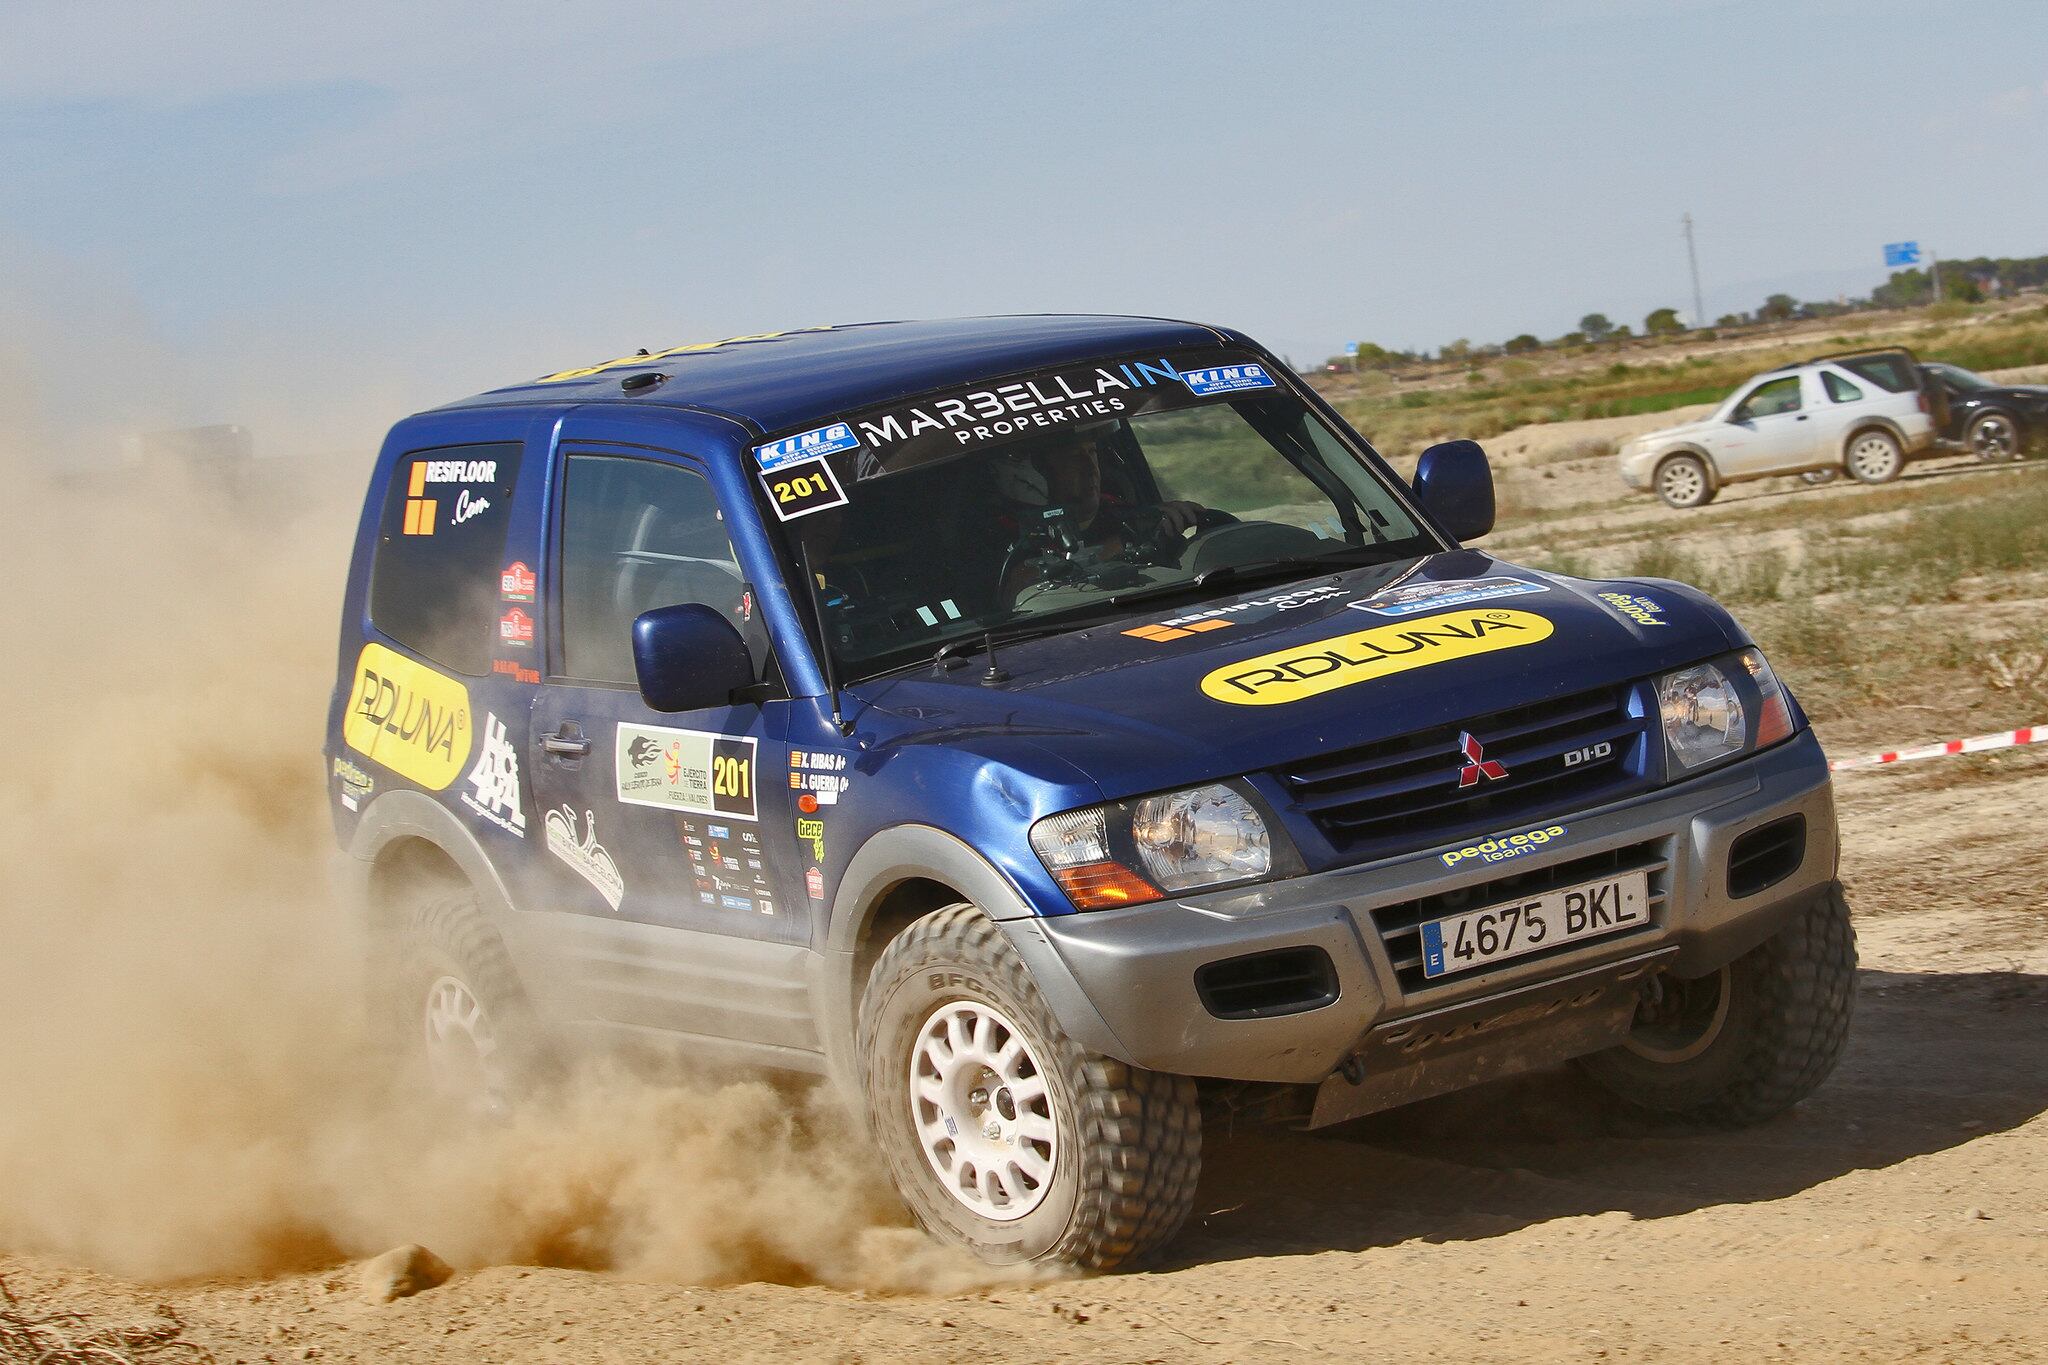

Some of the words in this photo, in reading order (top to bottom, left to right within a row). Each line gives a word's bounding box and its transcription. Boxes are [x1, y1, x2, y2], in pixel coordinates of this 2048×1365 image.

[1187, 366, 1261, 385] KING
[953, 397, 1127, 445] PROPERTIES
[760, 425, 846, 461] KING
[425, 460, 497, 482] RESIFLOOR
[773, 472, 829, 504] 201
[1161, 585, 1340, 626] RESIFLOOR
[1401, 586, 1527, 612] PARTICIPANTE
[811, 753, 835, 770] RIBAS
[835, 755, 847, 771] A+
[713, 755, 749, 798] 201
[809, 774, 839, 792] GUERRA
[799, 819, 822, 837] tece
[1442, 824, 1565, 867] pedrega
[1483, 842, 1536, 863] team
[1453, 901, 1547, 961] 4675
[1565, 883, 1637, 935] BKL
[1430, 953, 1440, 966] E
